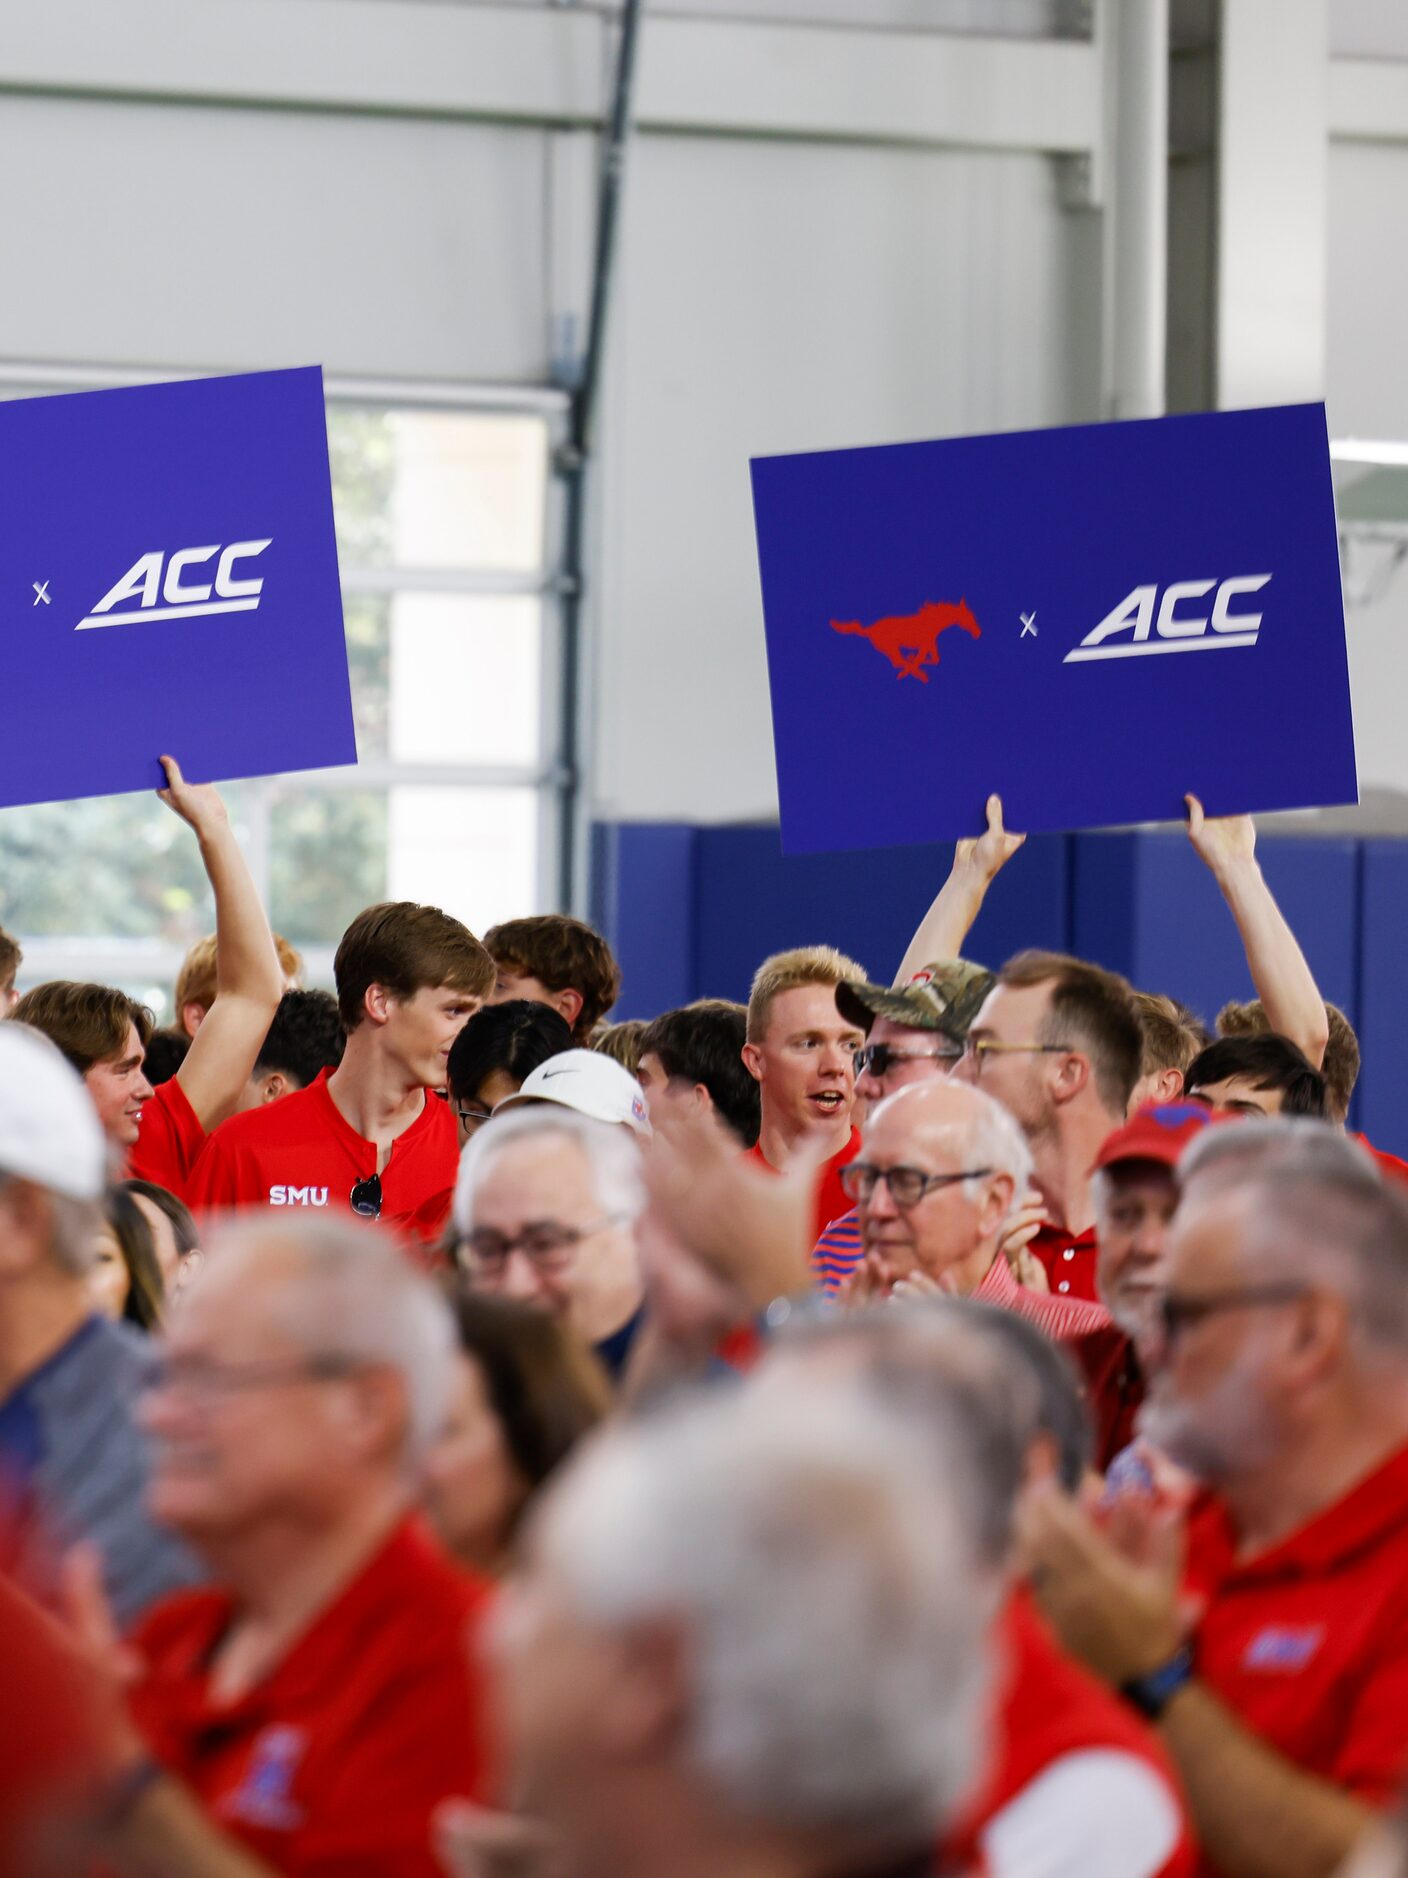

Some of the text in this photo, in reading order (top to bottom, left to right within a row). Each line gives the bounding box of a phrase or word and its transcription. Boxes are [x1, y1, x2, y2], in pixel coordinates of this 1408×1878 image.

[74, 537, 273, 631] ACC
[1063, 573, 1272, 663] ACC
[269, 1185, 328, 1207] SMU
